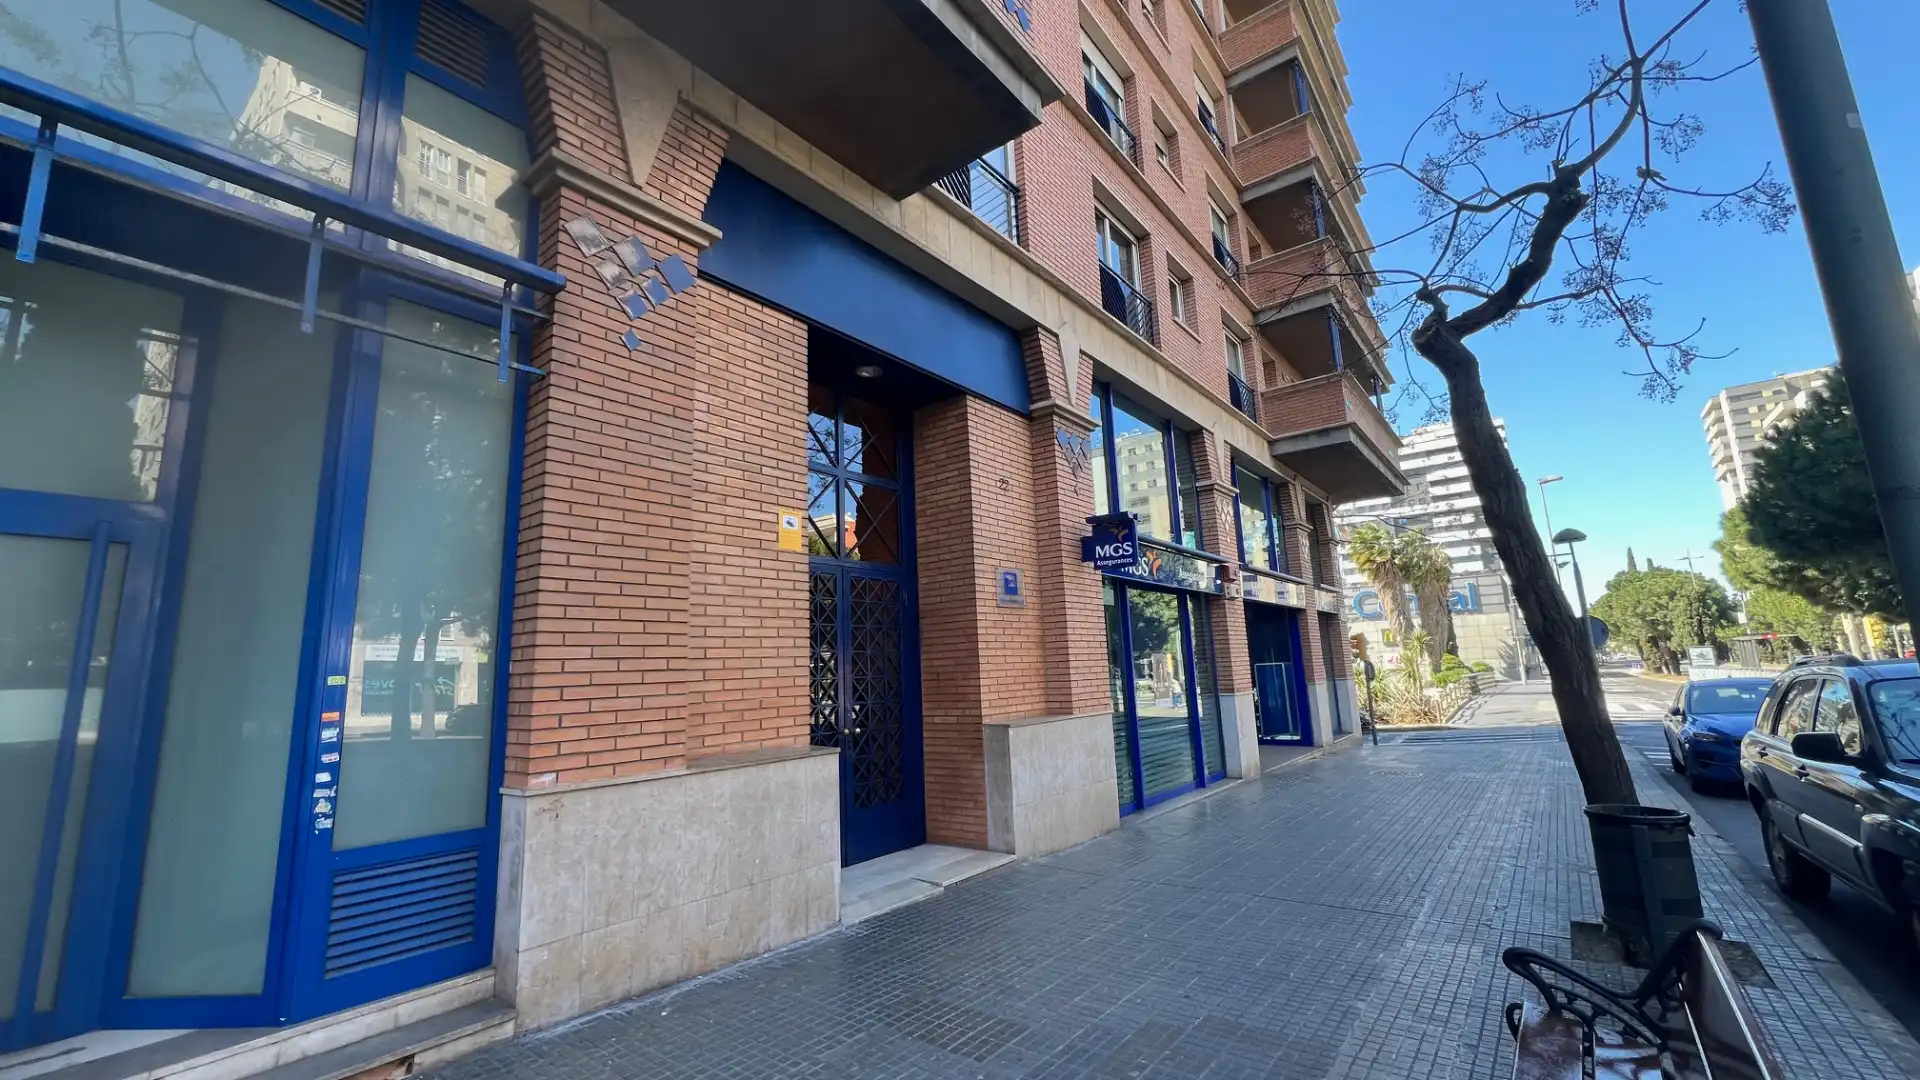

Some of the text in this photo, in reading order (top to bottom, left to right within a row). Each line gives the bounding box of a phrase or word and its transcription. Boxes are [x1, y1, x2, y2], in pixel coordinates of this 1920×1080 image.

[998, 477, 1011, 491] 22
[1095, 541, 1133, 558] MGS
[1096, 557, 1133, 566] Assegurances
[1352, 581, 1479, 619] Cnal
